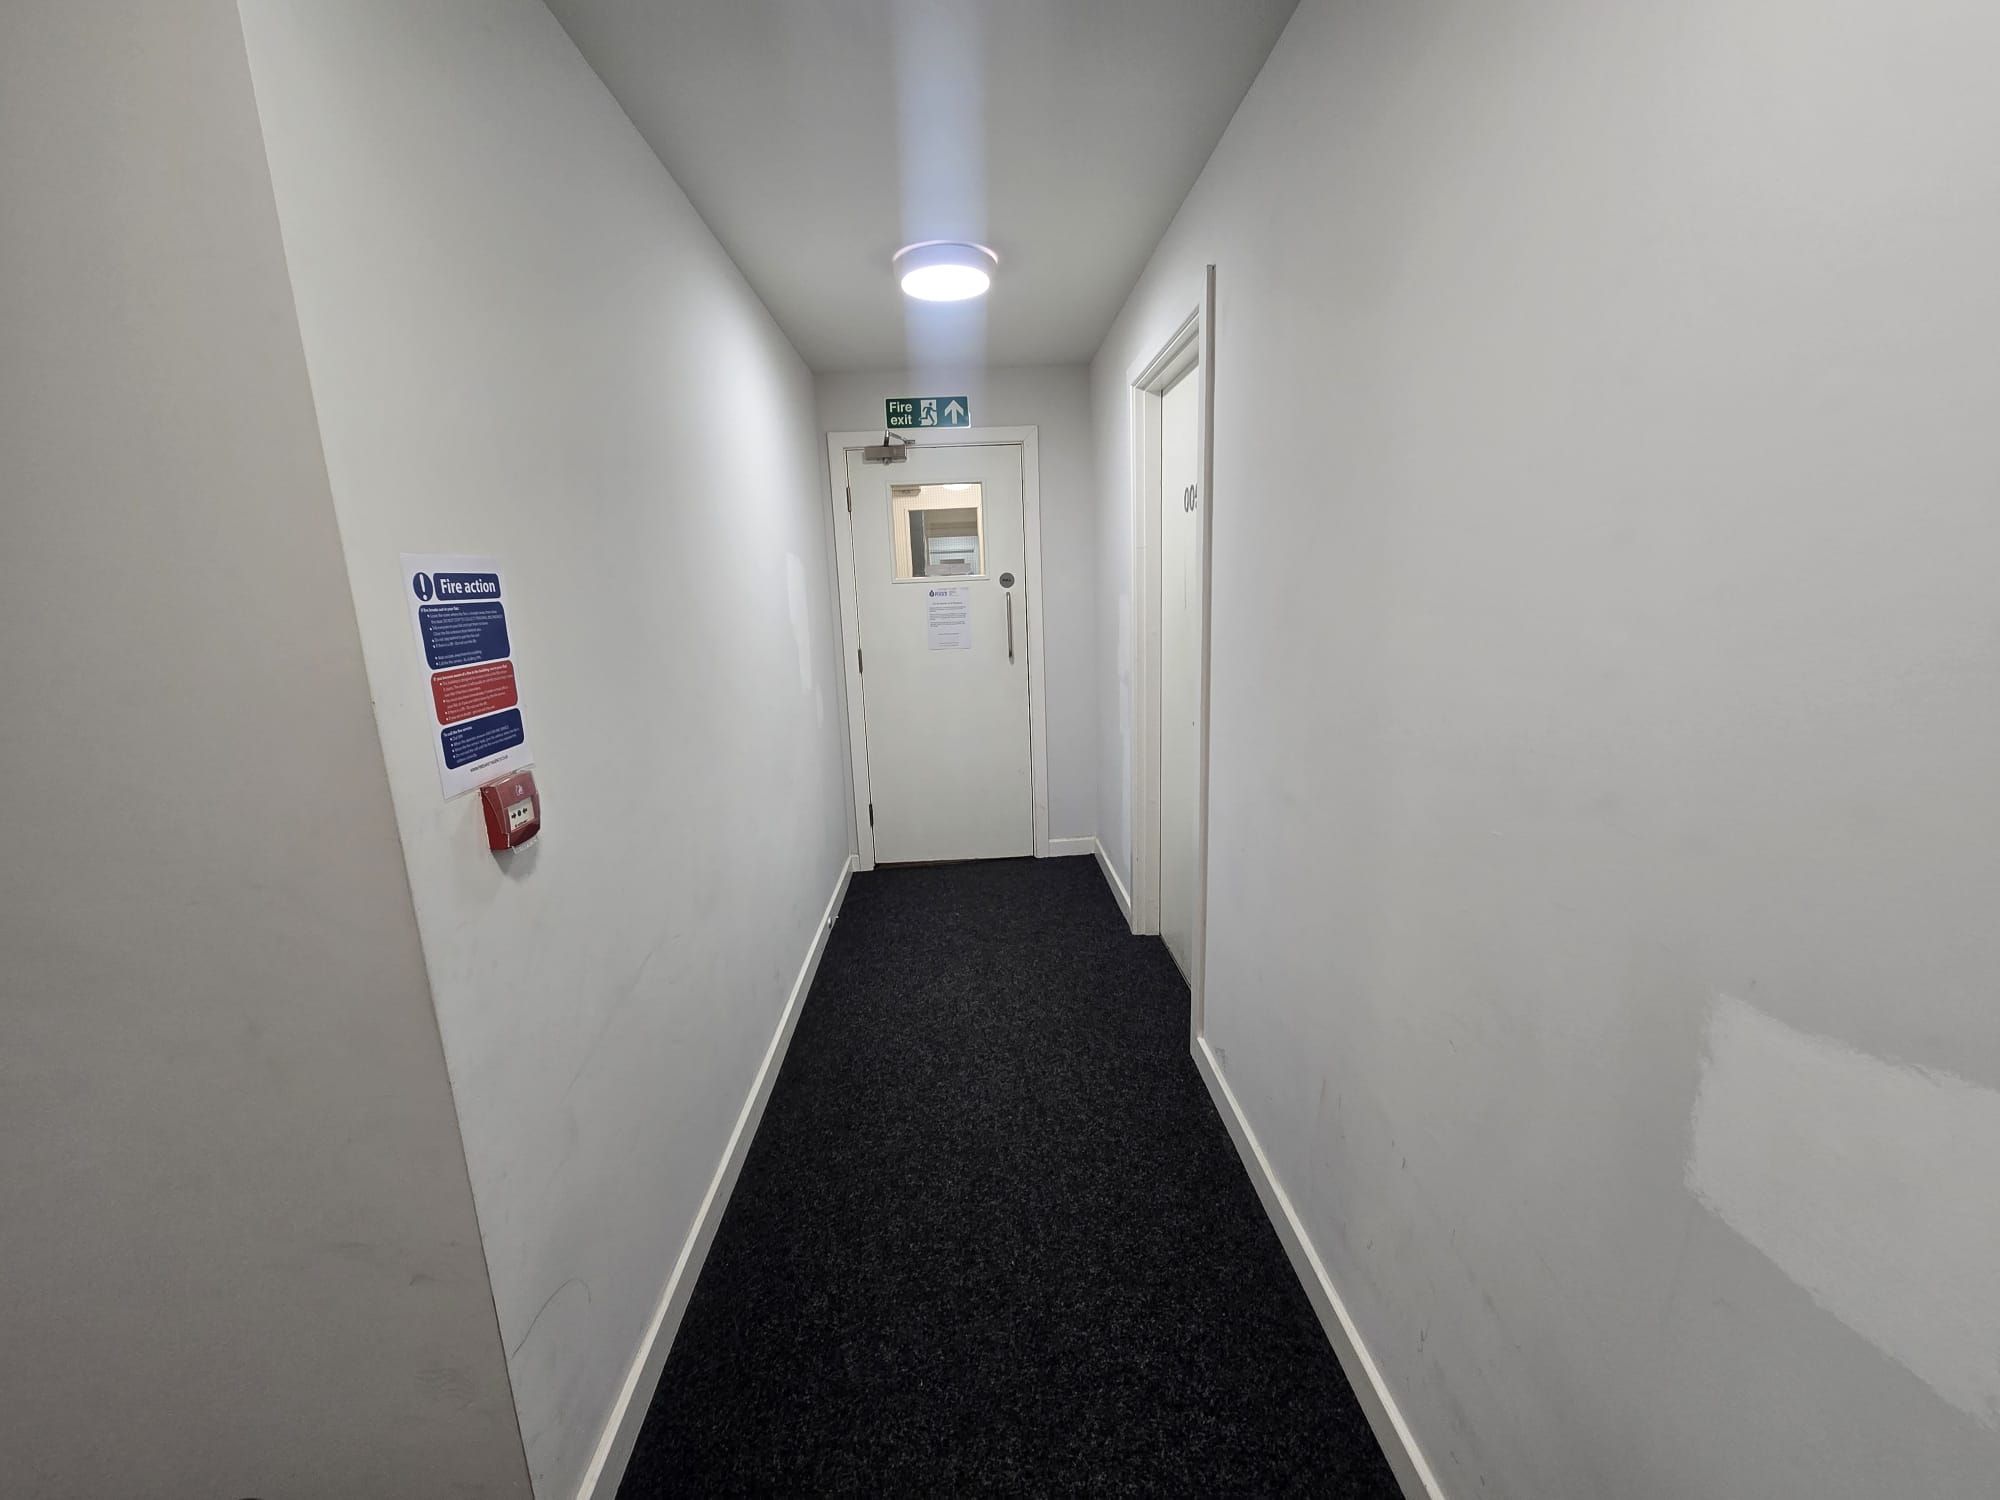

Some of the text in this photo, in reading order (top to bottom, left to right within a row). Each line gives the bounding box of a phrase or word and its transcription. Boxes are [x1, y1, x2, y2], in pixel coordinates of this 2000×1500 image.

[889, 401, 913, 413] Fire
[890, 414, 913, 425] exit
[440, 578, 496, 594] Fire action
